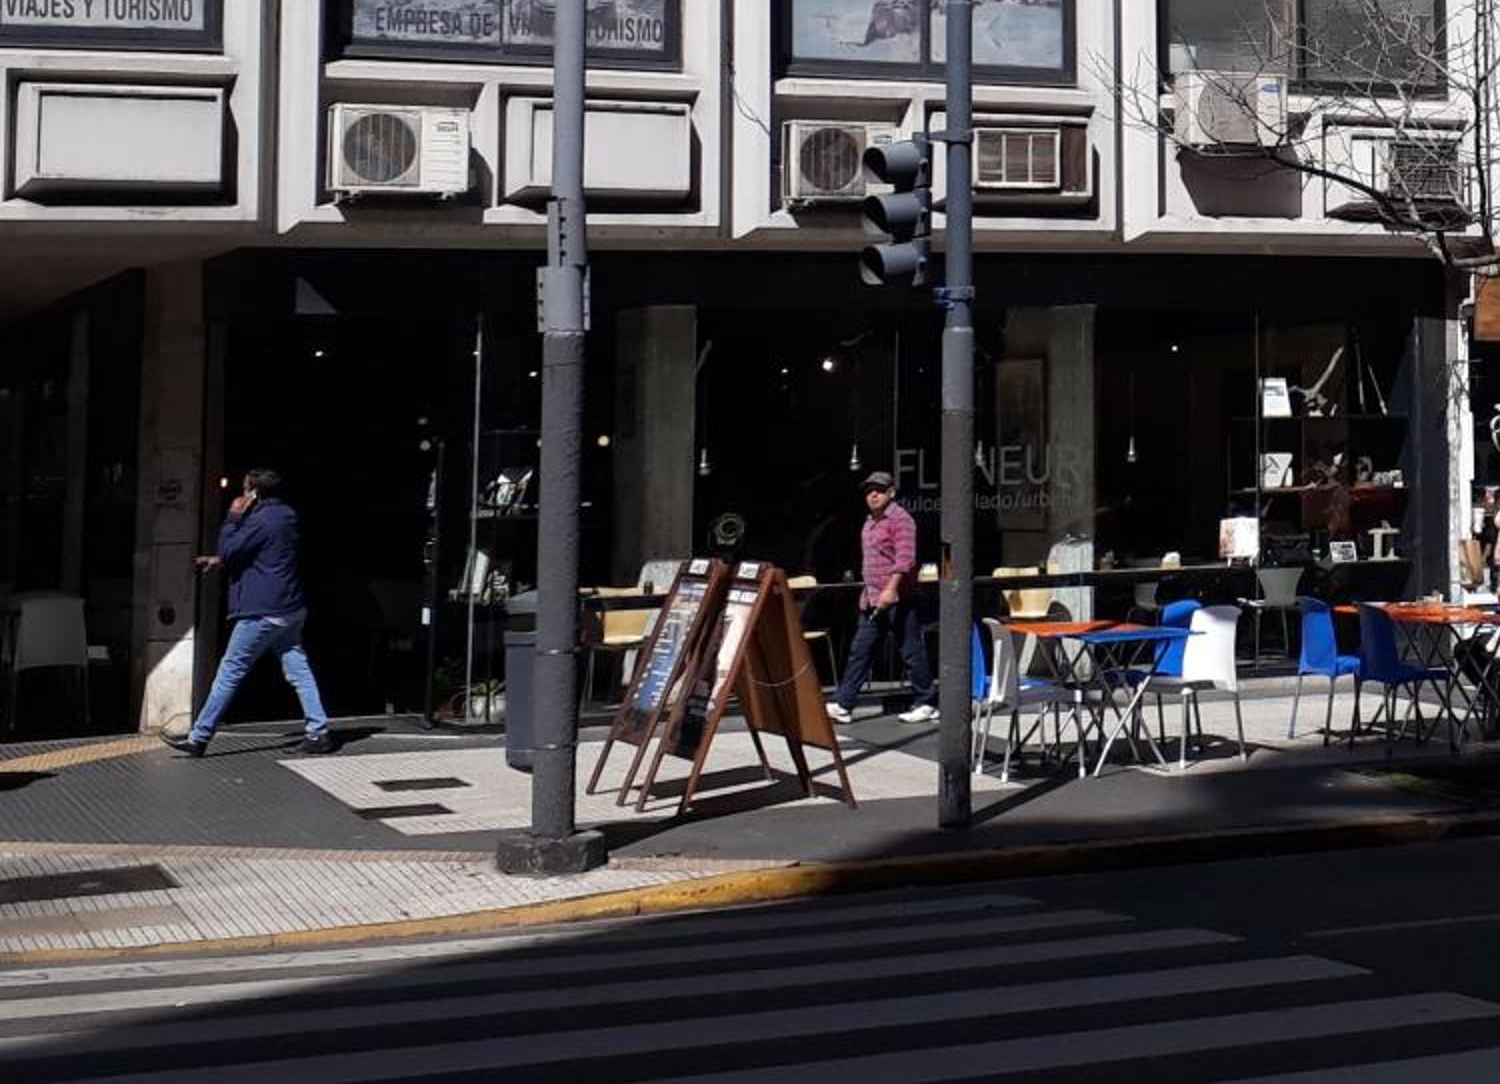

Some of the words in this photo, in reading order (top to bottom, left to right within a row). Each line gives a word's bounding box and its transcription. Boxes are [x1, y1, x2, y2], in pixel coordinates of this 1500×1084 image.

[375, 6, 463, 35] EMPRESA
[469, 12, 493, 36] DE
[895, 442, 1084, 489] FLNEUR
